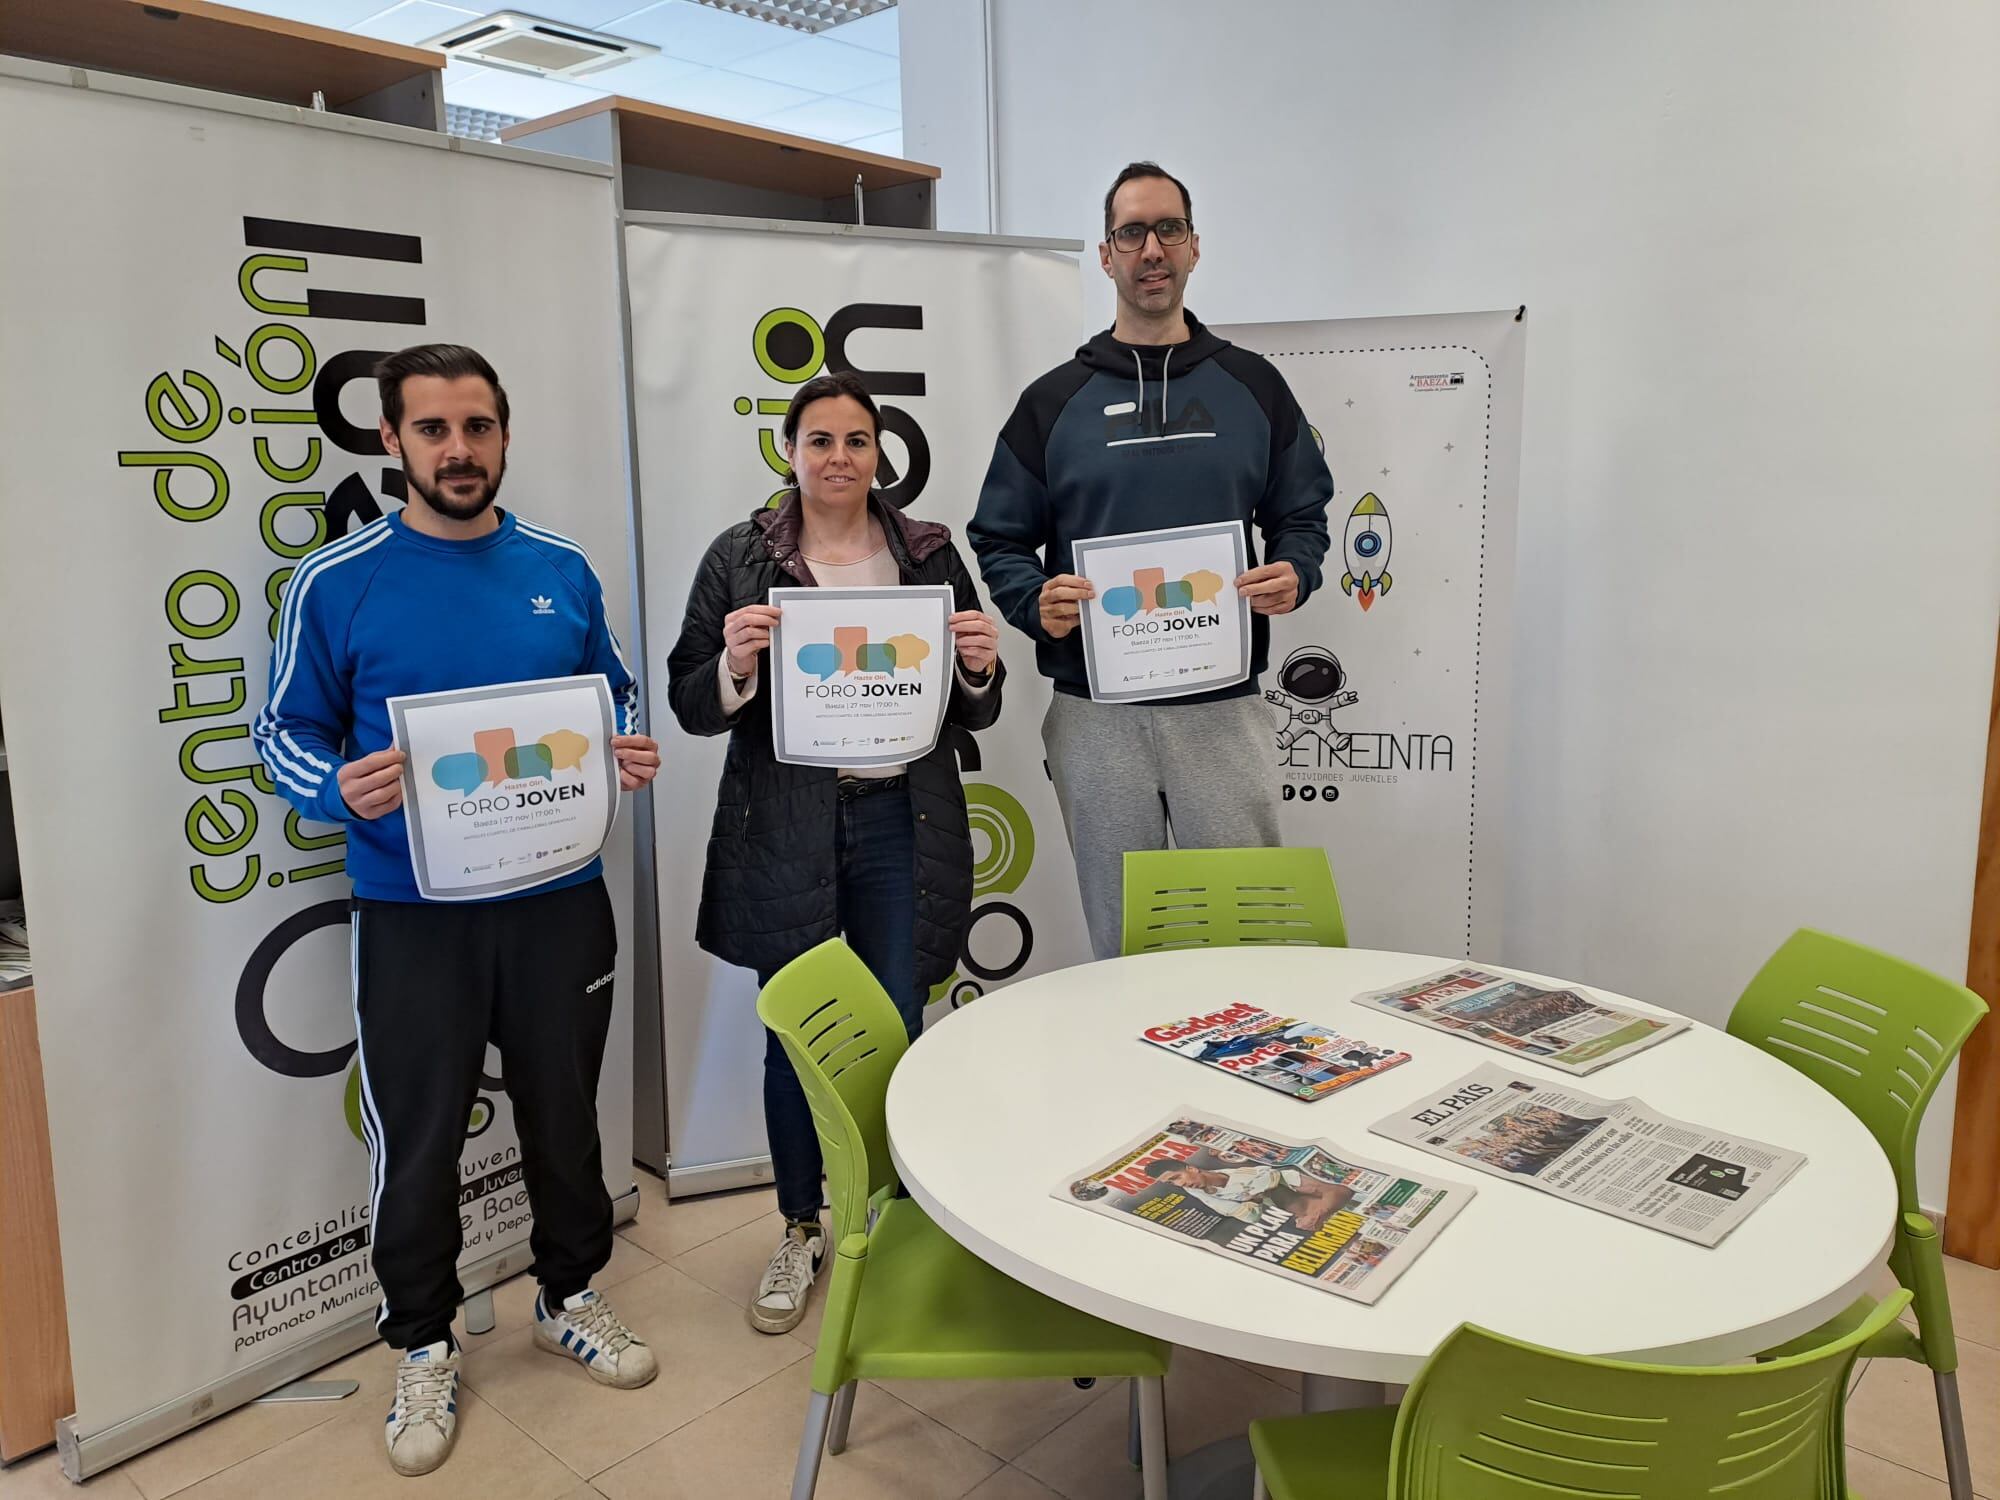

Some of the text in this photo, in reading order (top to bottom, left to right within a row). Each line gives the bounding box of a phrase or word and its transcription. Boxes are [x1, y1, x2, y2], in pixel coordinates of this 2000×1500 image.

[1416, 378, 1449, 387] BAEZA
[117, 369, 261, 904] centro de
[1112, 613, 1220, 639] FORO JOVEN
[805, 682, 922, 698] FORO JOVEN
[1286, 772, 1398, 784] ACTIVIDADES JUVENILES
[447, 783, 585, 819] FORO JOVEN
[473, 819, 498, 828] Baeza
[503, 815, 513, 824] 27
[535, 809, 554, 818] 17:00
[1144, 1001, 1264, 1042] Gadget
[1169, 1036, 1188, 1049] La
[1187, 1027, 1224, 1045] nueva
[1219, 1042, 1289, 1071] Portal
[1410, 1083, 1494, 1126] EL PAÍS
[1244, 1205, 1294, 1238] PLAN
[1226, 1232, 1263, 1253] UN
[1253, 1231, 1305, 1263] PARA
[1281, 1209, 1368, 1275] BELLINGHAM
[250, 1252, 321, 1291] Centro
[329, 1236, 357, 1259] de
[235, 1309, 316, 1352] Patronato
